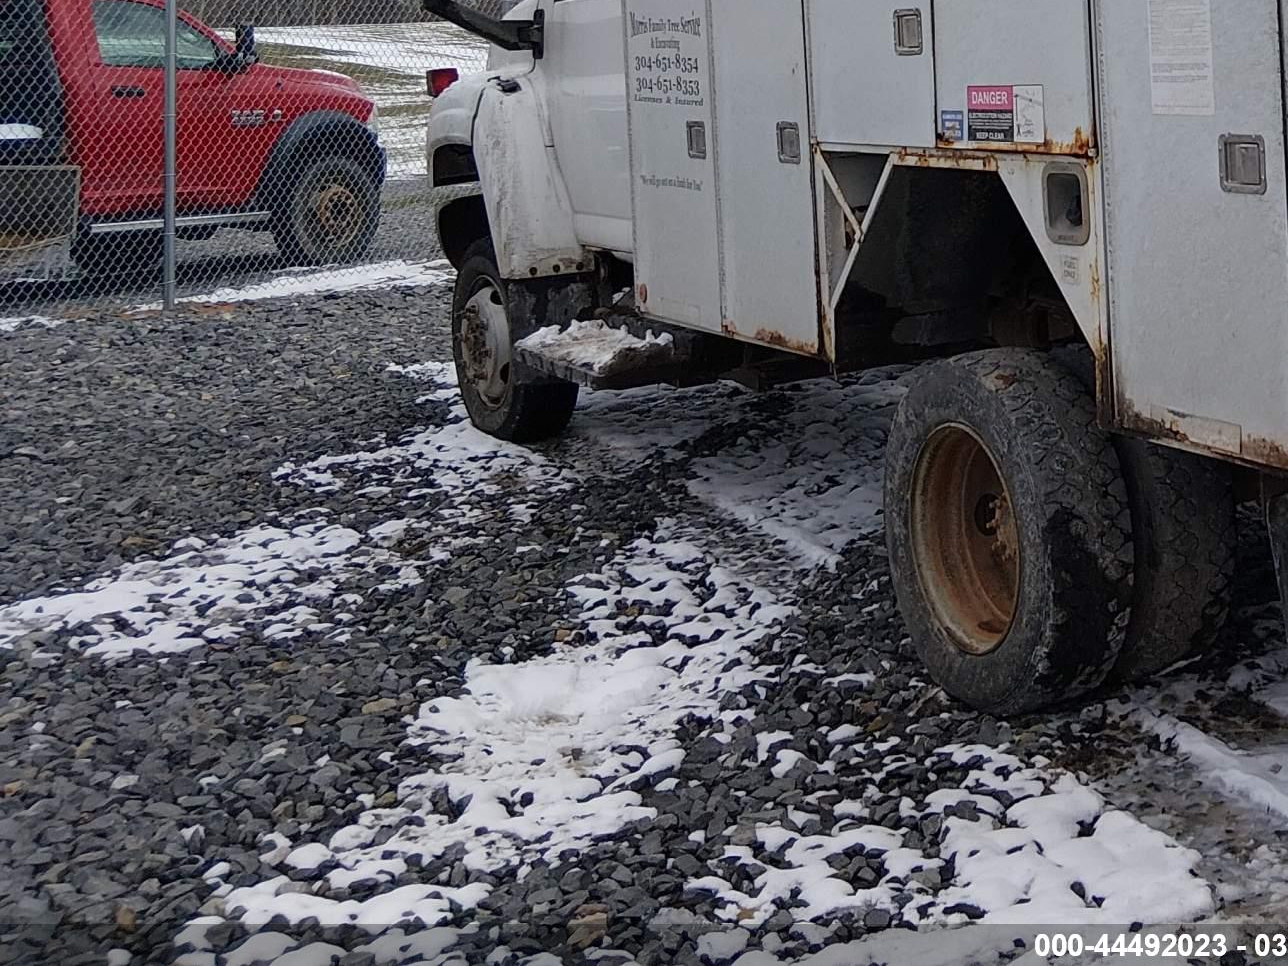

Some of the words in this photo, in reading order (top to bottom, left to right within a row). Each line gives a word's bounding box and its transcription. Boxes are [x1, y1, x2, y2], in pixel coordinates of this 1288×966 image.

[667, 19, 680, 32] Tree
[680, 10, 701, 37] Service
[635, 53, 699, 73] 304-651-8354
[636, 75, 700, 96] 304-651-8353
[674, 97, 704, 107] Insured
[971, 91, 1008, 105] DANGER
